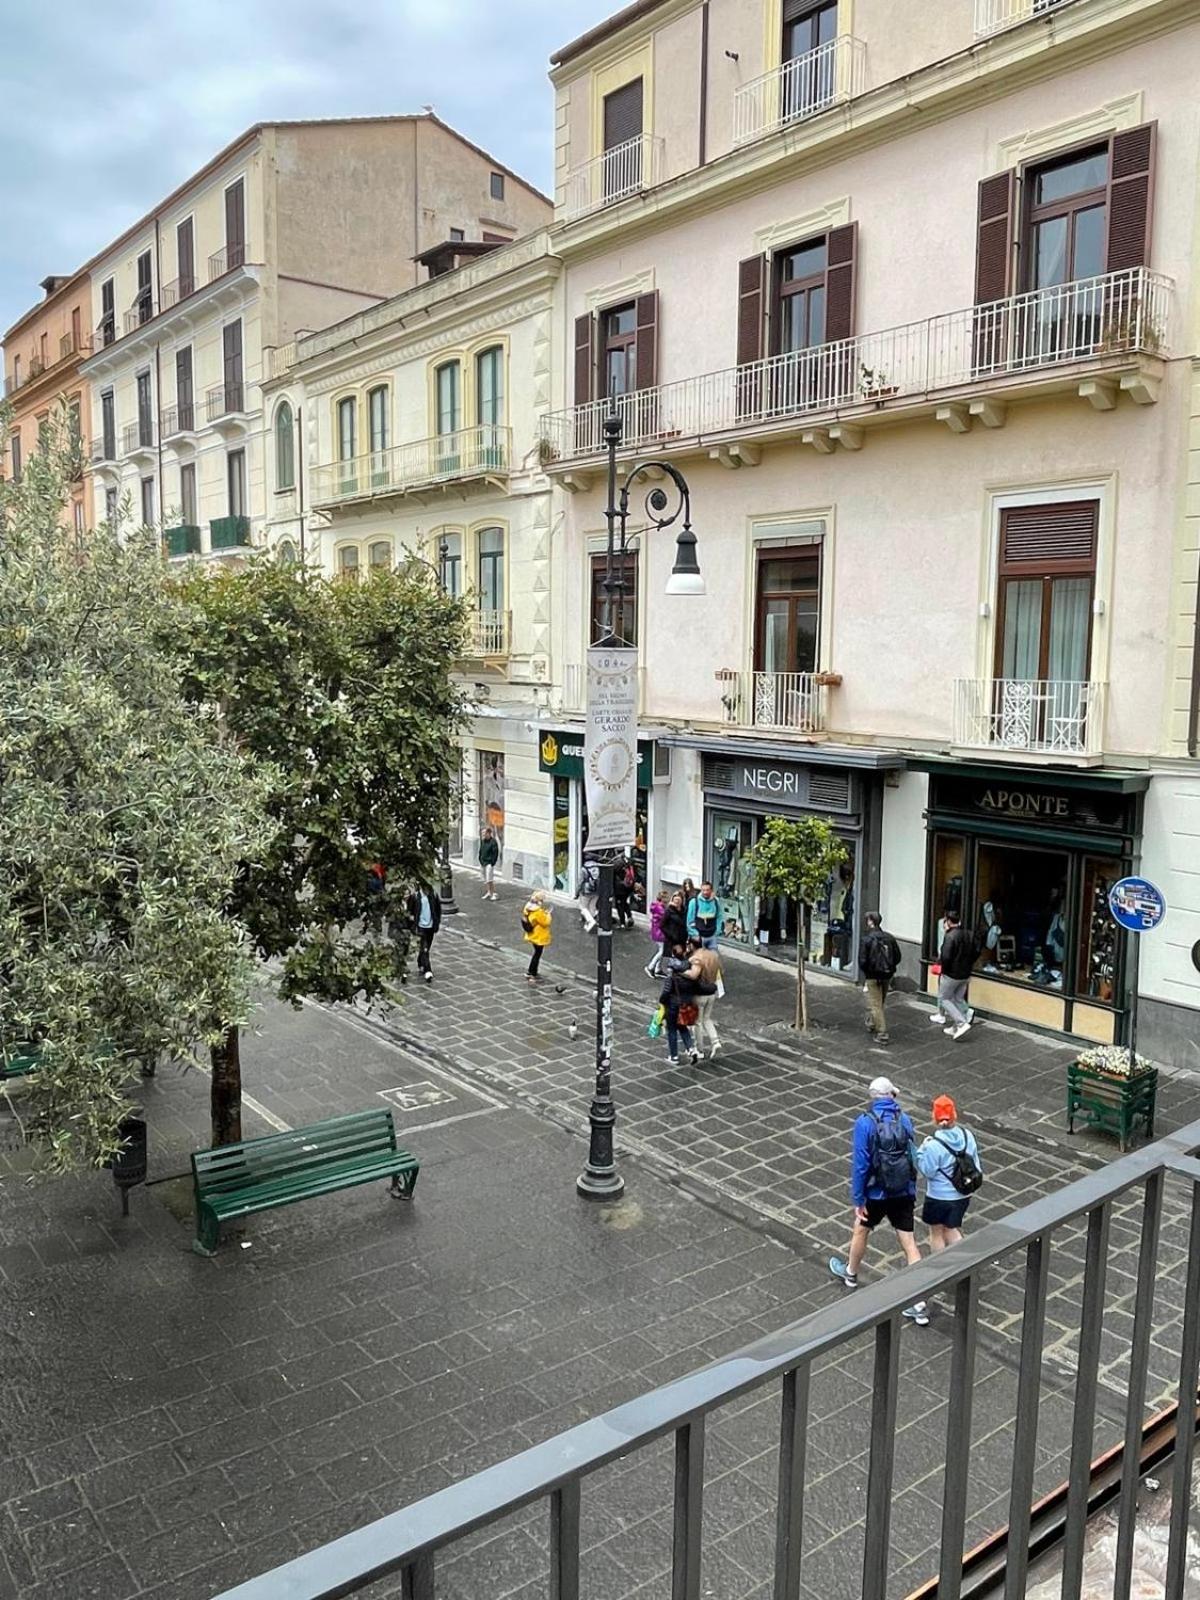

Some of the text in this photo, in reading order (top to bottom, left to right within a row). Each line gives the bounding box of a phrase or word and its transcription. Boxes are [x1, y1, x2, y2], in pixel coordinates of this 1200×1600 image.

[601, 724, 626, 733] SACCO
[562, 744, 585, 758] QUE
[743, 767, 799, 793] NEGRI
[979, 789, 1070, 816] APONTE
